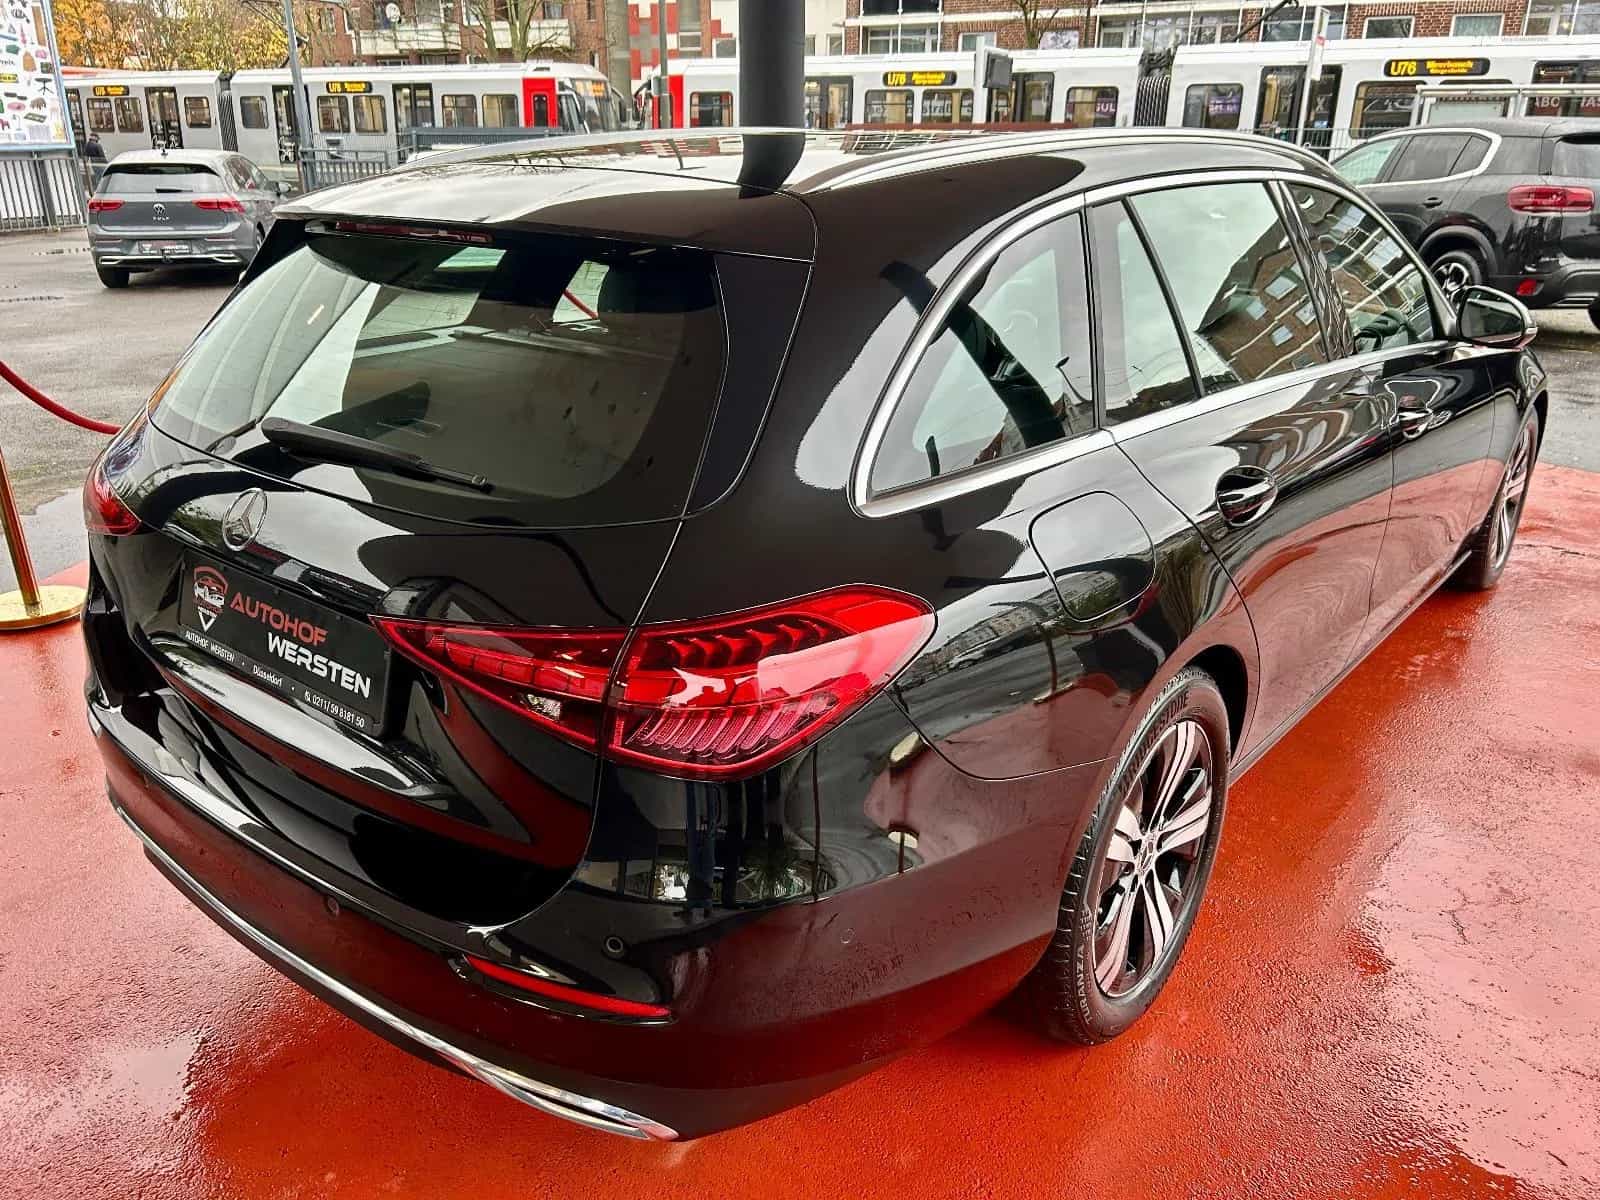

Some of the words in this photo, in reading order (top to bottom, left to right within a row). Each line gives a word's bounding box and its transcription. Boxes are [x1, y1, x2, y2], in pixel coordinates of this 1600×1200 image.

[887, 71, 906, 87] U76
[1390, 60, 1417, 76] U76
[229, 591, 329, 647] AUTOHOF
[185, 630, 209, 649] AUTOHOF
[210, 642, 235, 662] WERSTEN
[253, 664, 283, 687] Düsseldorf
[267, 631, 372, 698] WERSTEN
[1076, 942, 1094, 1025] TURANZA
